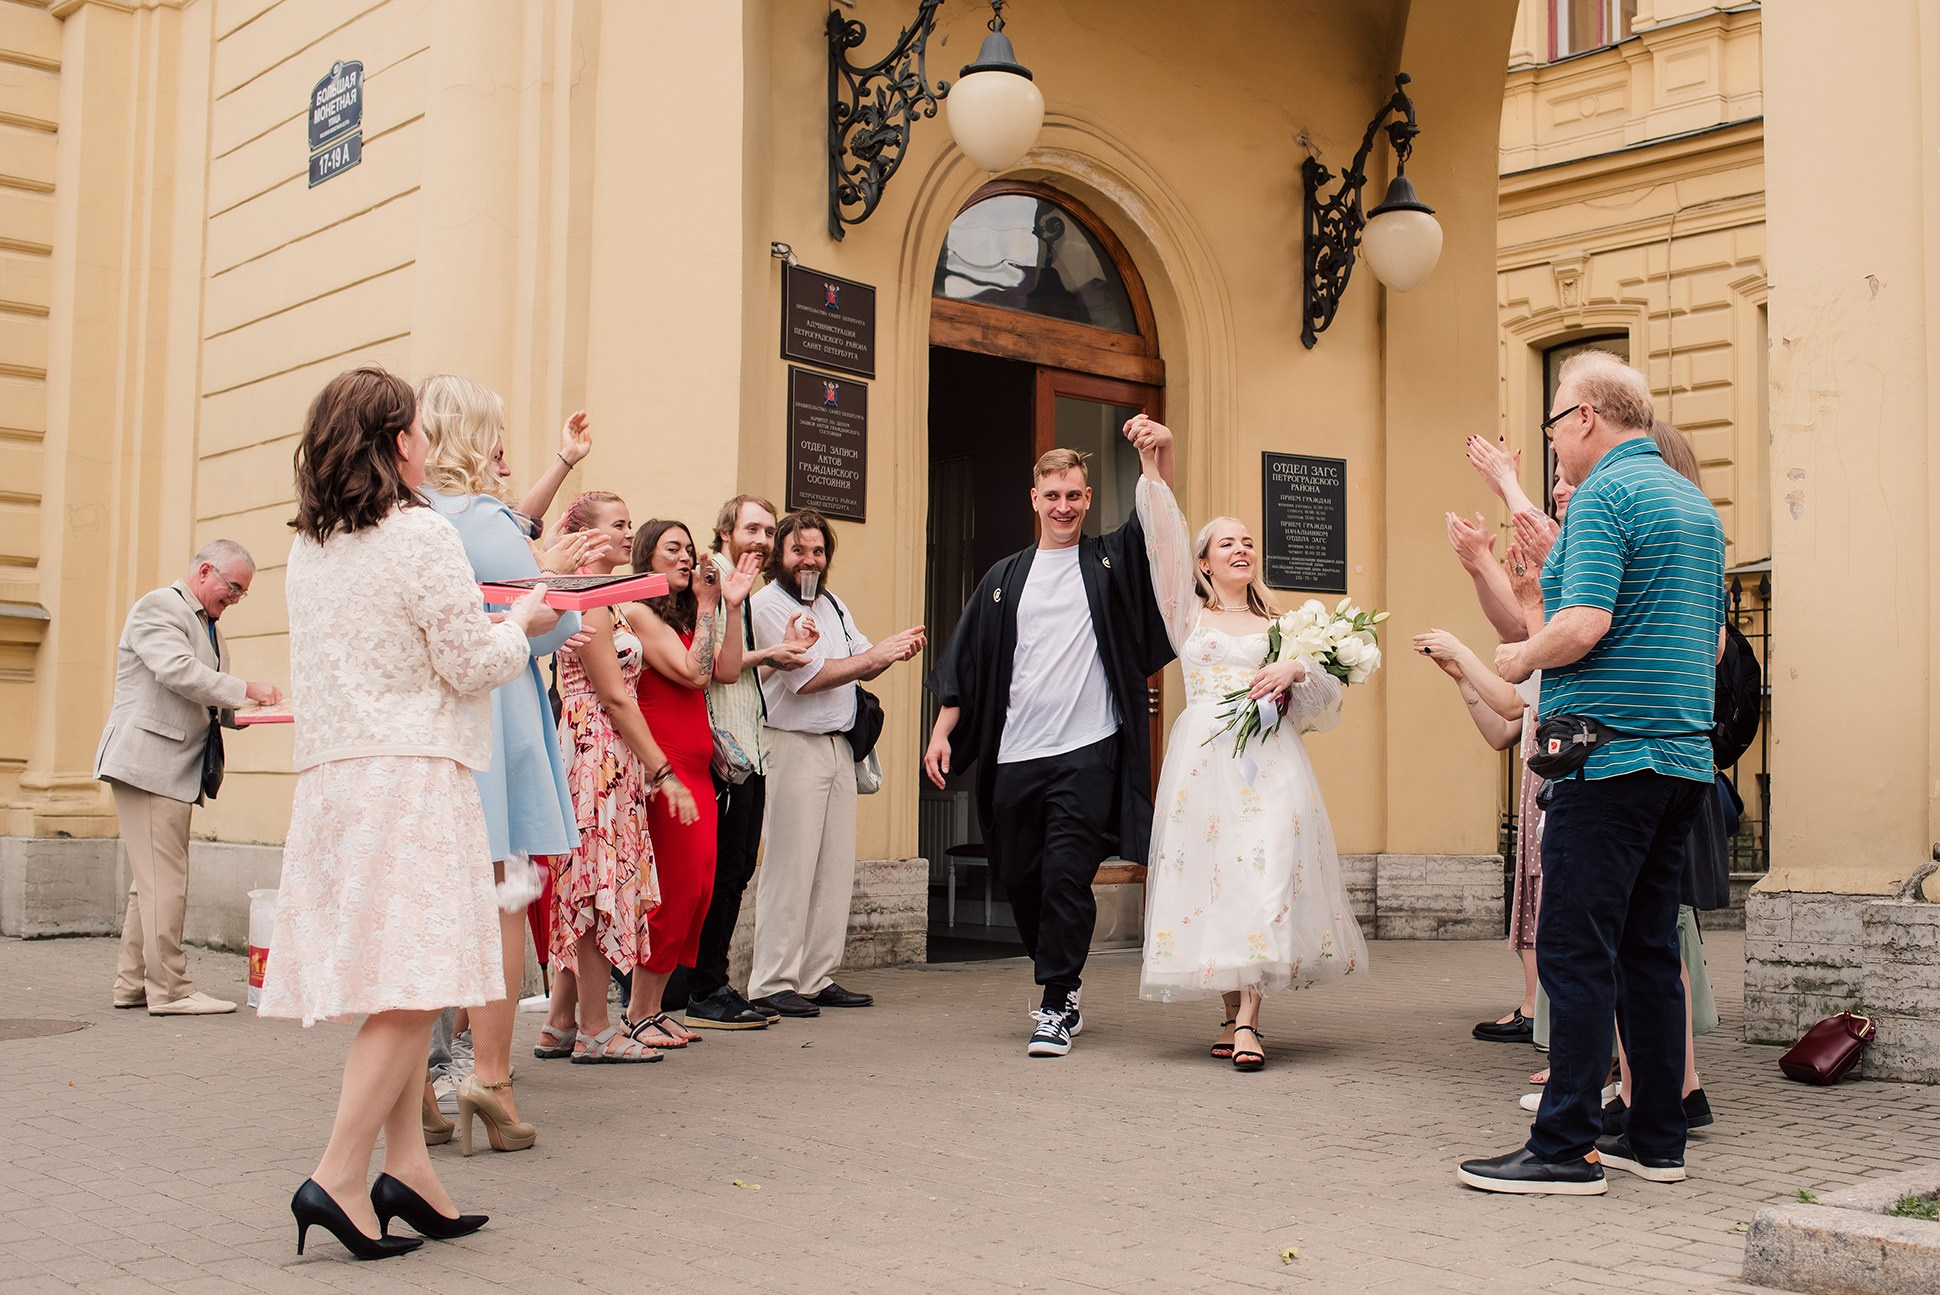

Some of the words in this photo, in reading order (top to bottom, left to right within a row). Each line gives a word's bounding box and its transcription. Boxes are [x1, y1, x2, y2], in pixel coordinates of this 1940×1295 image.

[316, 71, 357, 106] БОЛЬШАЯ
[313, 88, 357, 125] МОНЕТНАЯ
[319, 147, 342, 176] 17-19
[342, 143, 350, 165] А
[806, 319, 856, 338] АДМИНИСТРАЦИЯ
[793, 327, 844, 346] ПЕТРОГРАДСКОГО
[845, 340, 868, 352] РАЙОНА
[800, 440, 827, 453] ОТДЕЛ
[829, 445, 859, 459] ЗАПИСИ
[818, 455, 842, 467] АКТОВ
[799, 461, 860, 480] ГРАЖДАНСКОГО
[1272, 462, 1307, 475] ОТДЕЛ
[1311, 466, 1338, 478] ЗАГС
[806, 474, 852, 490] СОСТОЯНИЯ
[1272, 473, 1340, 487] ПЕТРОГРАДСКОГО
[1291, 483, 1321, 493] РАЙОНА
[1280, 494, 1302, 502] ПРИЕМ
[1302, 496, 1332, 505] ГРАЖДАН
[1280, 520, 1302, 528] ПРИЕМ
[1302, 522, 1333, 531] ГРАЖДАН
[1284, 528, 1328, 538] НАЧАЛЬНИКОМ
[1286, 535, 1310, 543] ОТДЕЛА
